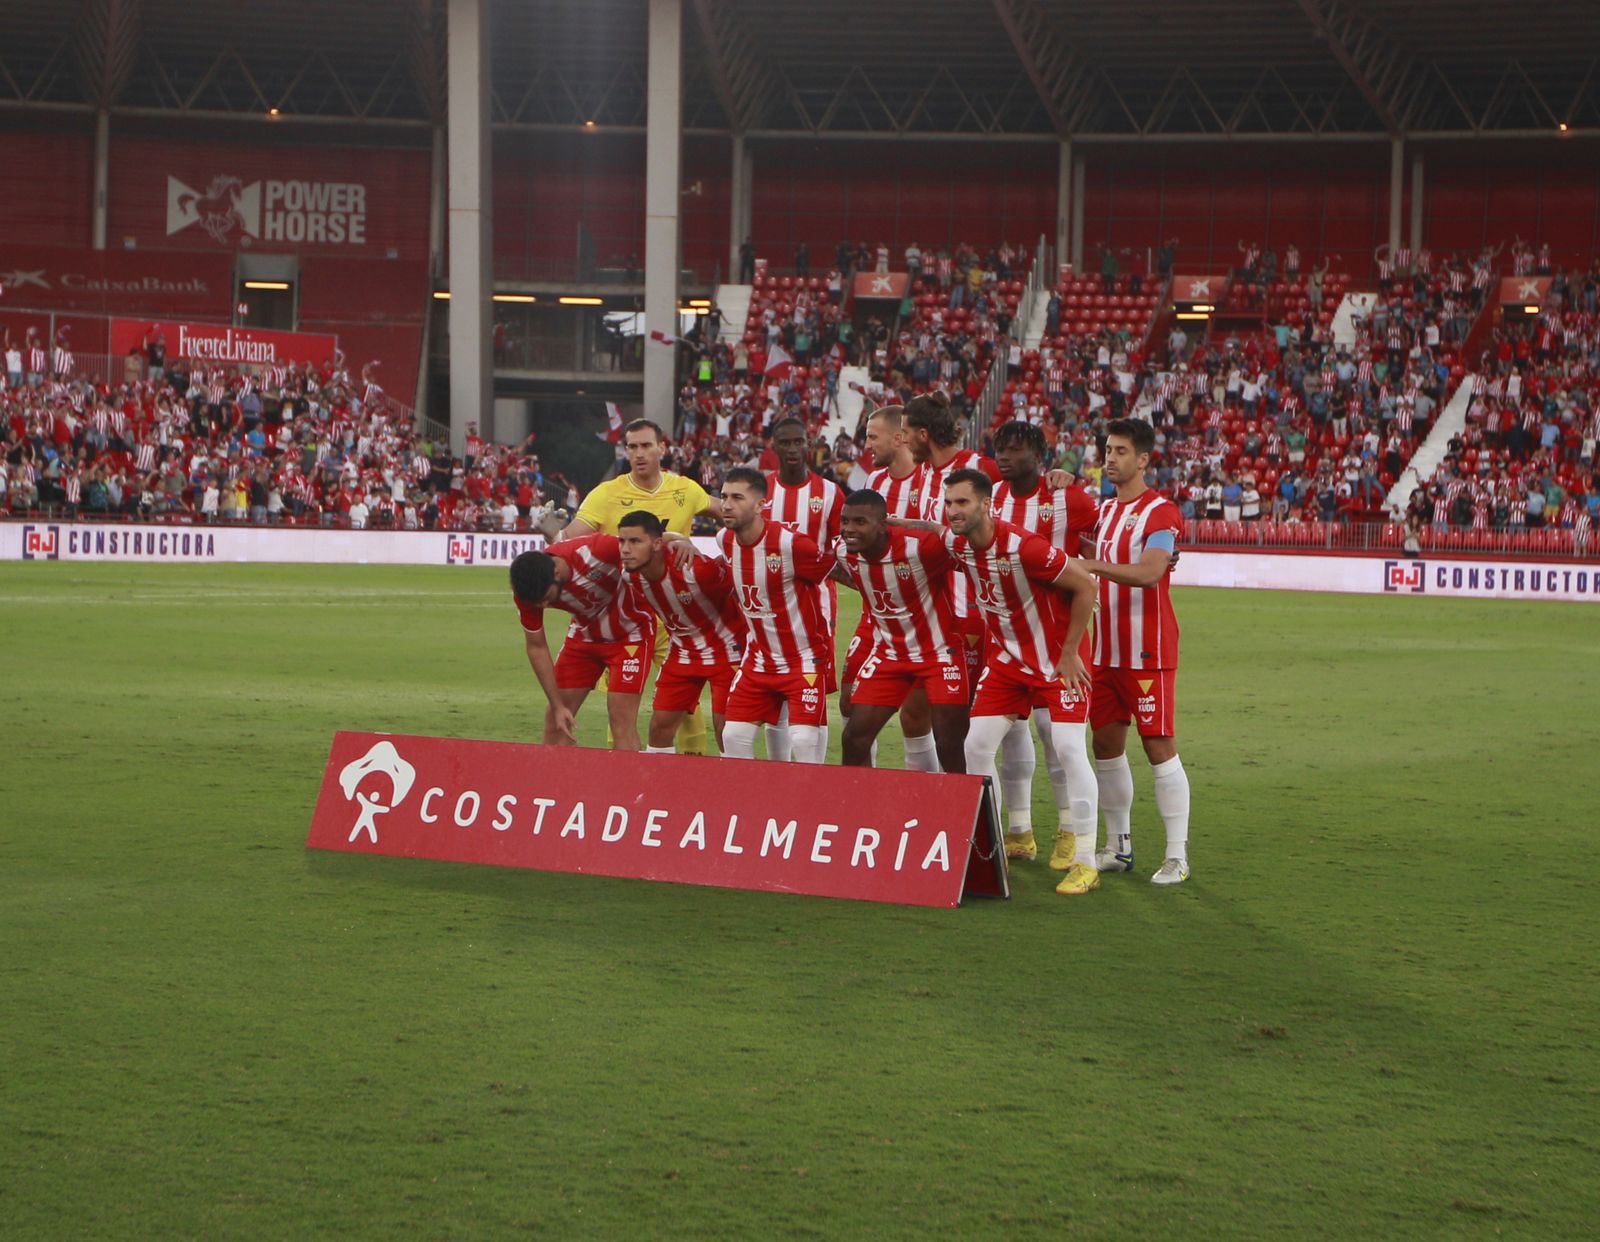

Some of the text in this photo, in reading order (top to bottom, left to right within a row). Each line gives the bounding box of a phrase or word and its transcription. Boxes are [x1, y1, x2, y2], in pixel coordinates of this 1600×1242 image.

[265, 180, 366, 212] POWER
[265, 211, 366, 244] HORSE
[60, 273, 208, 294] CaixaBank
[178, 325, 275, 363] FuenteLiviana
[69, 530, 215, 557] CONSTRUCTORA
[1060, 693, 1080, 703] KUU
